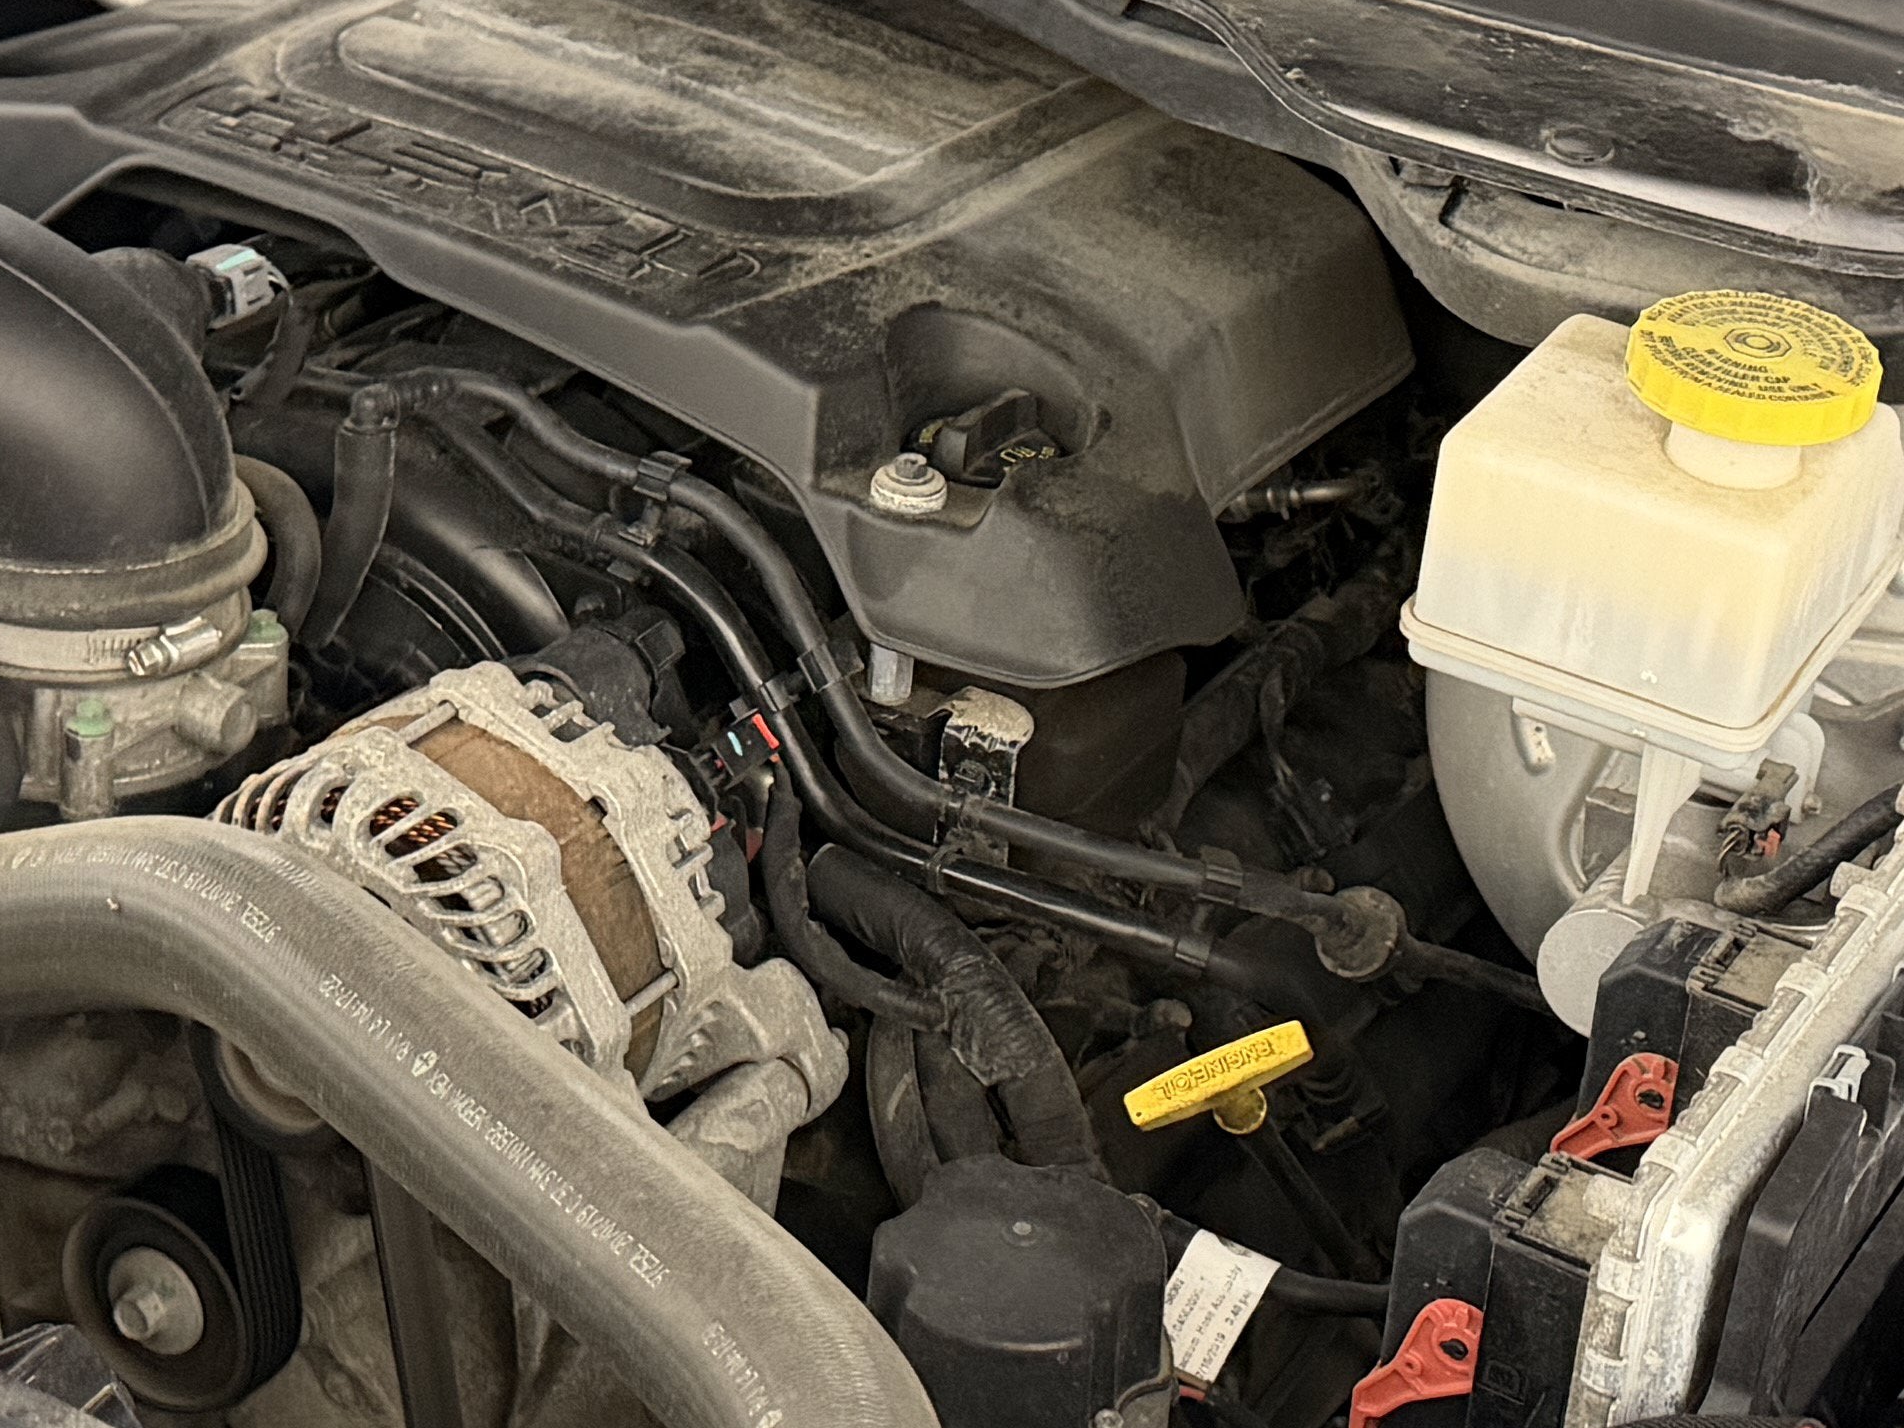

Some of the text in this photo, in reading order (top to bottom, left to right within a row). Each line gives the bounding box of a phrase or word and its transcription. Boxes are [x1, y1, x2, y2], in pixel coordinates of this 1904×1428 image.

[1712, 366, 1760, 383] FILLER
[1764, 375, 1791, 384] CAP
[1758, 385, 1784, 393] USE
[1154, 1038, 1274, 1102] ENGINE OIL
